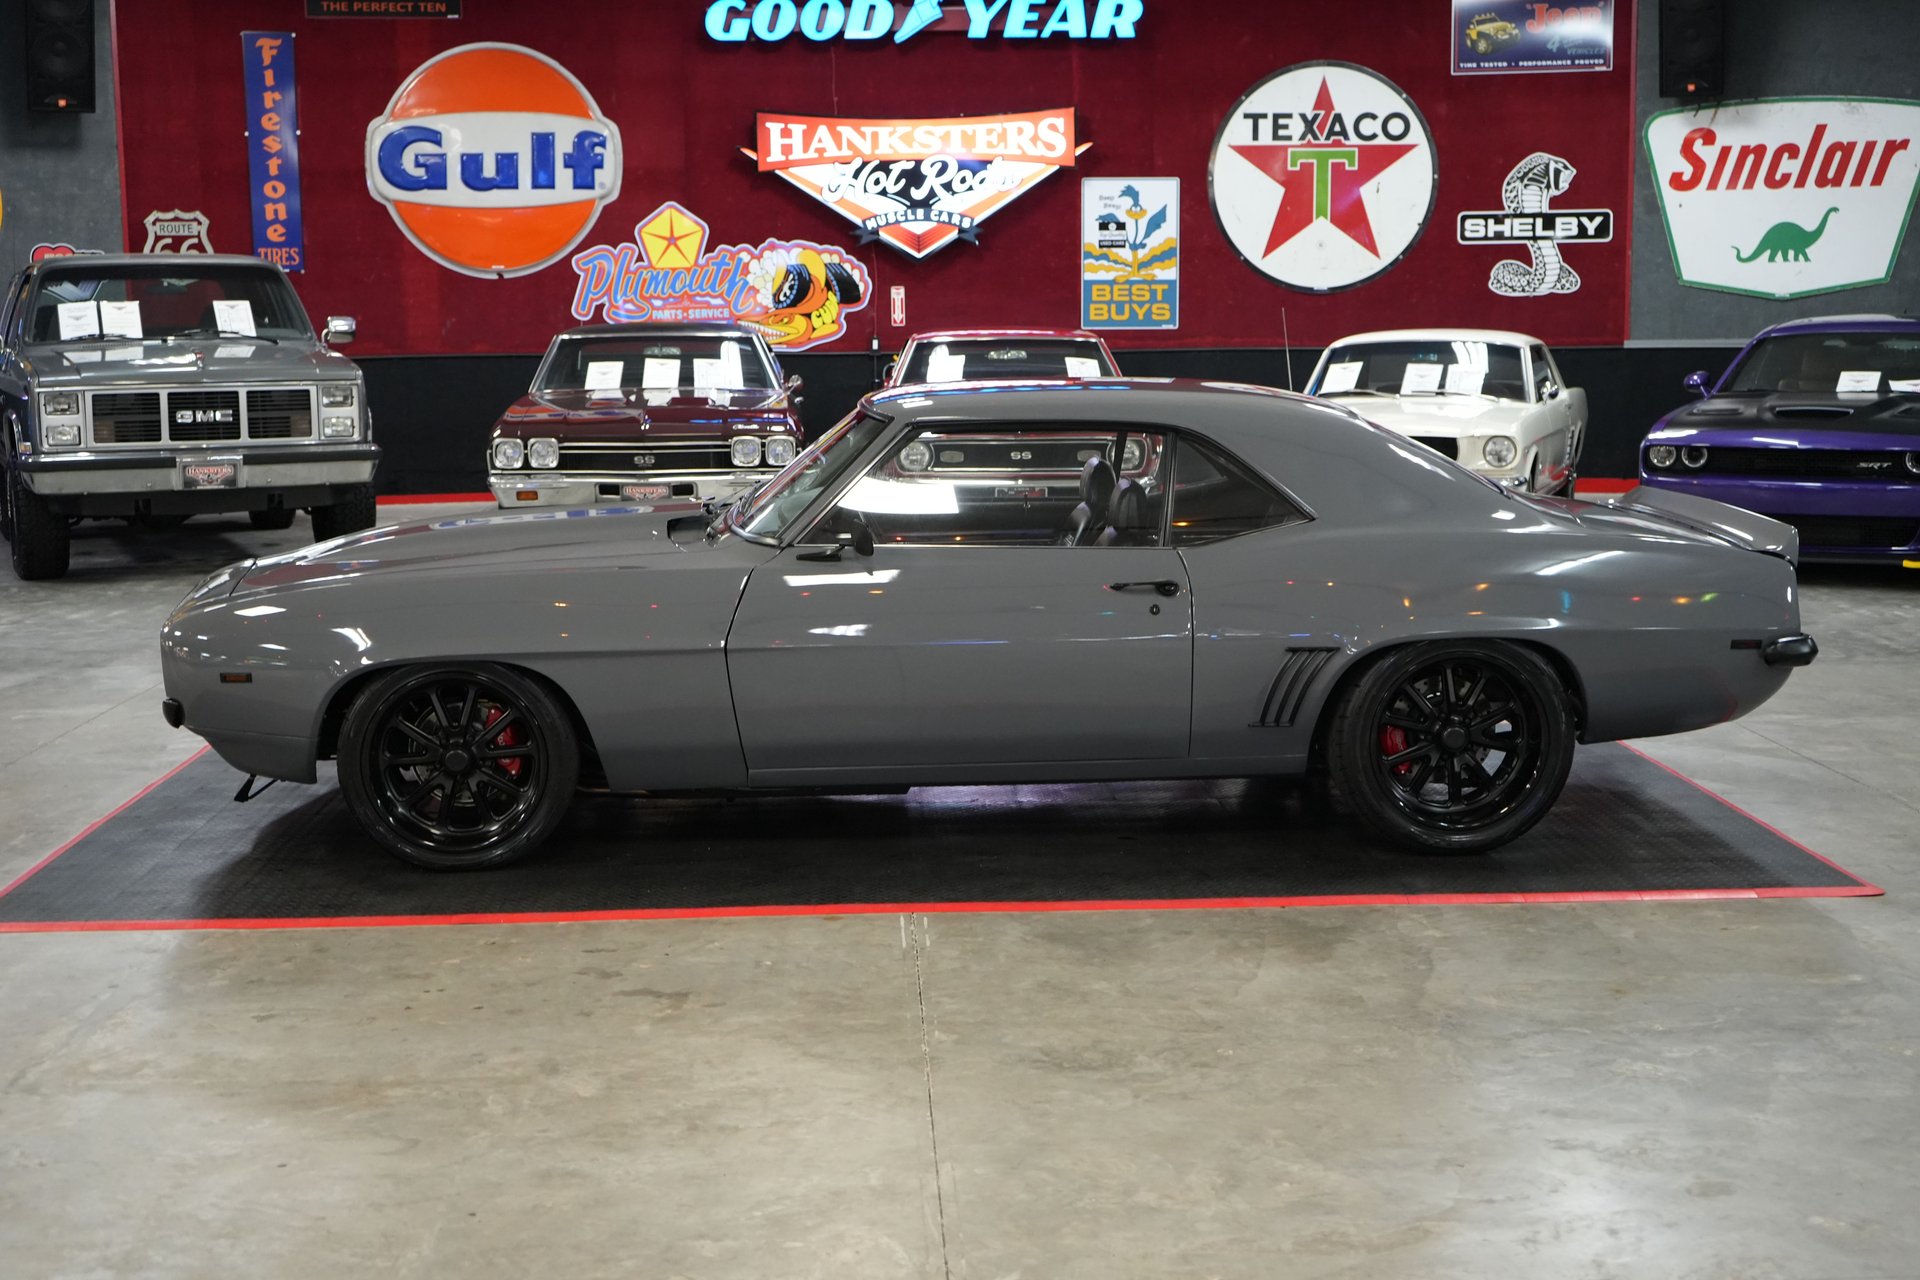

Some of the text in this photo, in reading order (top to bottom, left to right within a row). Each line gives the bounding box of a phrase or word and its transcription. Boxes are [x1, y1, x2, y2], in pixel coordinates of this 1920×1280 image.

[321, 2, 446, 12] THE PERFECT TEN
[1518, 59, 1571, 67] PERFORMANCE
[1574, 58, 1604, 66] PROVED
[1243, 112, 1411, 142] TEXACO
[255, 37, 287, 242] Firestone
[765, 117, 1067, 162] HANKSTERS
[378, 125, 607, 192] Gulf
[1669, 124, 1911, 192] Sinclair
[822, 156, 916, 202] Hot
[1289, 148, 1358, 222] T
[158, 223, 194, 234] ROUTE
[865, 208, 972, 231] MUSCLE CARS
[1464, 216, 1604, 238] SHELBY
[258, 247, 300, 268] TIRES
[580, 250, 752, 320] Plymouth
[1091, 284, 1169, 302] BEST
[652, 308, 730, 320] PARTS SERVICE
[1089, 303, 1171, 321] BUYS
[176, 409, 233, 423] GMC
[634, 455, 656, 465] SS
[1010, 451, 1032, 460] SS
[1856, 462, 1892, 470] SRT
